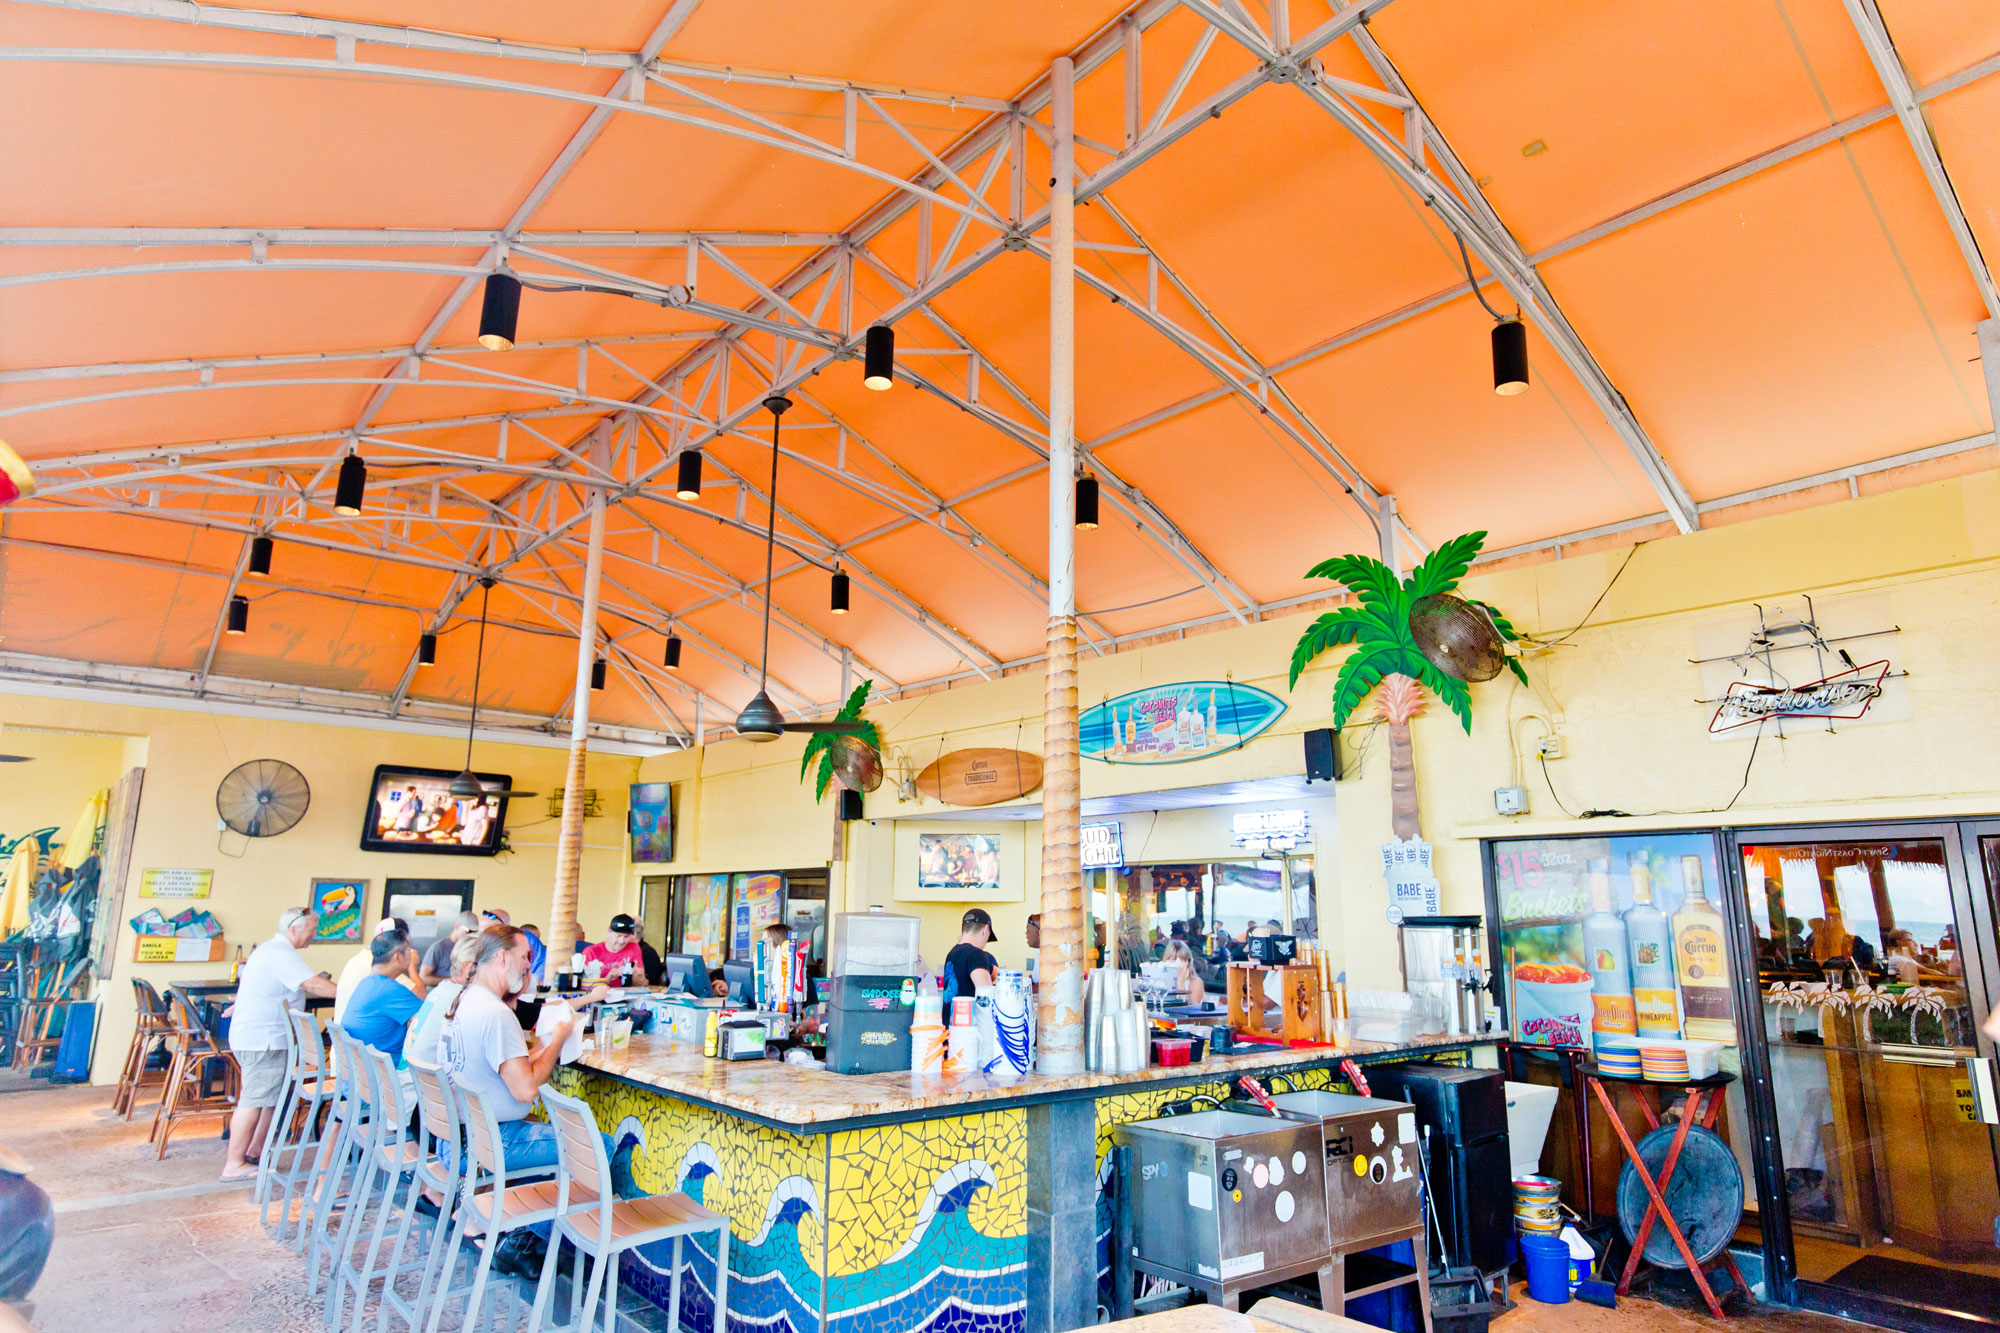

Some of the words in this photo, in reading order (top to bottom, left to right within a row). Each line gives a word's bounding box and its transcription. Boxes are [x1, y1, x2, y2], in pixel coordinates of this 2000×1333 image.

[1140, 695, 1178, 714] COCONUTS
[1728, 683, 1873, 717] Budweiser
[1155, 708, 1177, 724] BEACH
[1496, 850, 1544, 889] $15
[1397, 883, 1422, 896] BABE
[1425, 886, 1437, 913] BABE
[1503, 887, 1588, 922] Buckets
[319, 913, 355, 937] WOMEN
[1684, 940, 1717, 954] Cuervo
[1640, 1013, 1673, 1021] PINEAPPLE
[1548, 1029, 1584, 1046] BEACH
